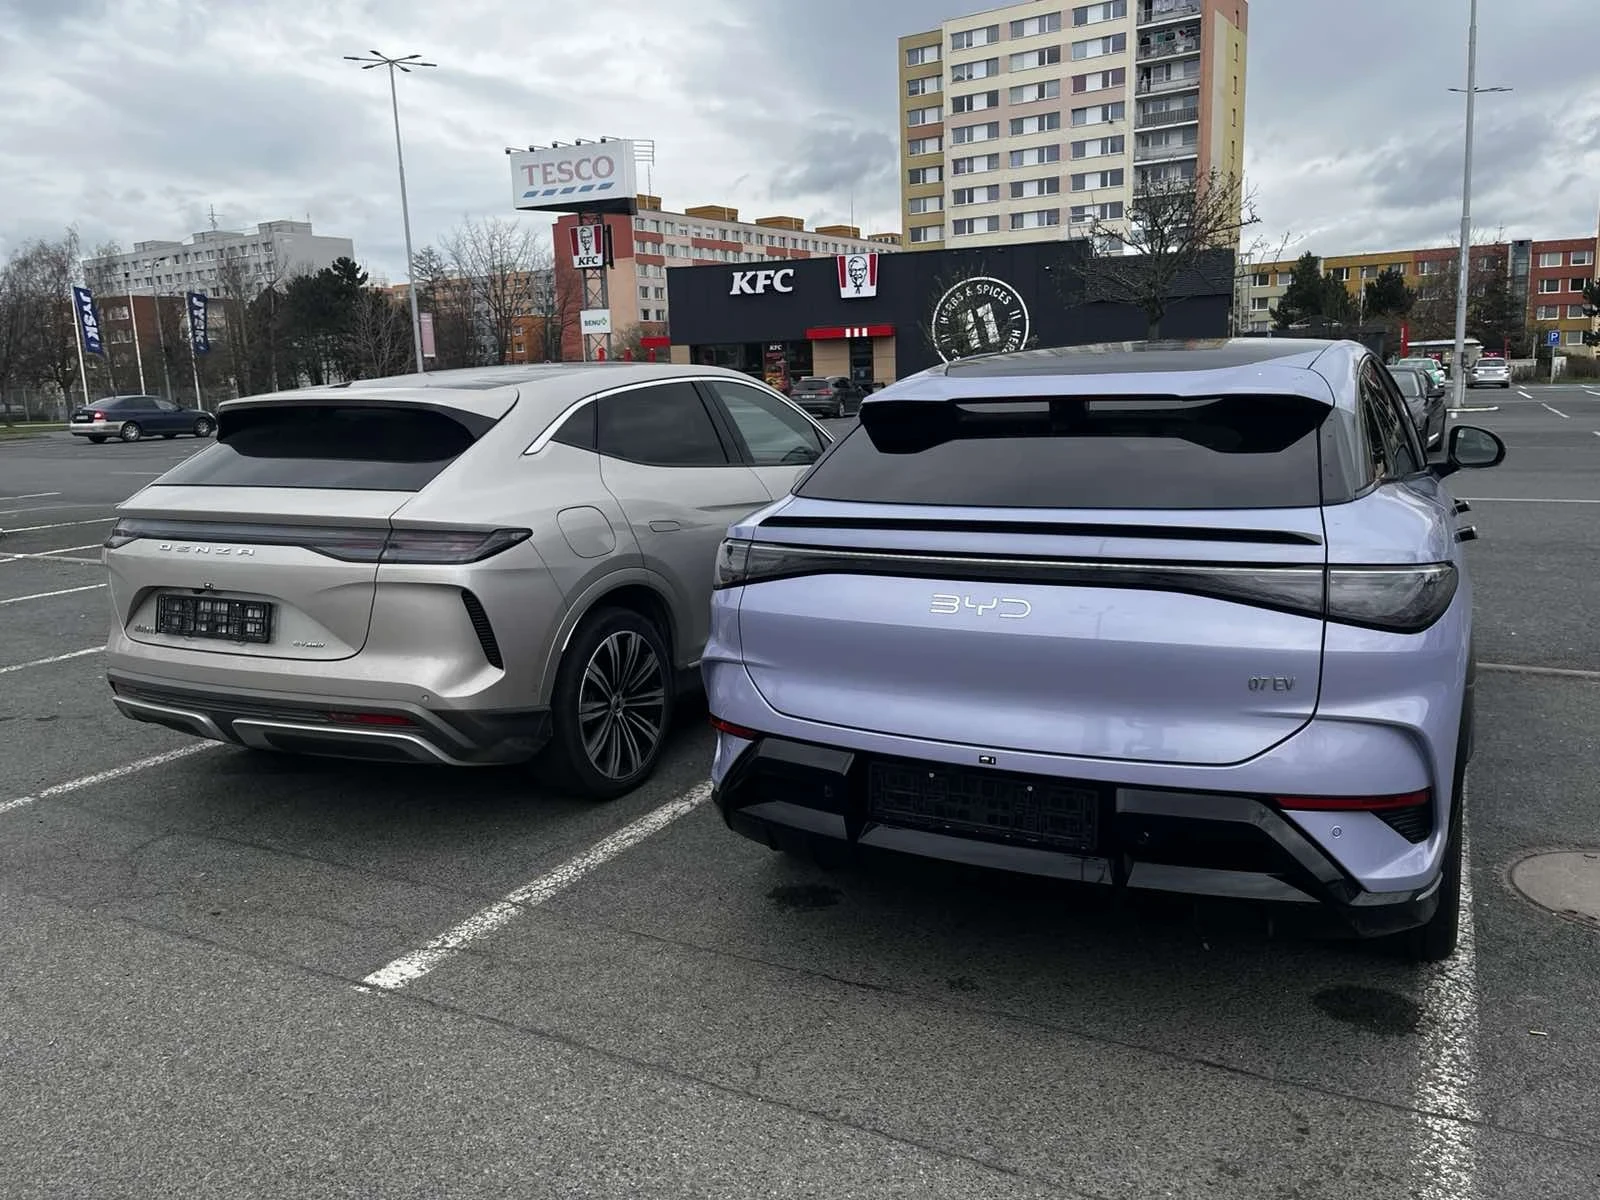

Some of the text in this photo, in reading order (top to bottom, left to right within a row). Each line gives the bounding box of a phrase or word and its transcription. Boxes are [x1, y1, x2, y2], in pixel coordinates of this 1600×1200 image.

[520, 156, 615, 186] TESCO
[578, 256, 599, 266] KFC
[730, 269, 794, 295] KFC
[976, 284, 1012, 304] SPICES
[80, 291, 100, 341] JYSK
[1551, 332, 1559, 341] P
[159, 543, 255, 557] DENZA
[930, 593, 1032, 618] BYD
[1248, 677, 1295, 691] 07 EV
